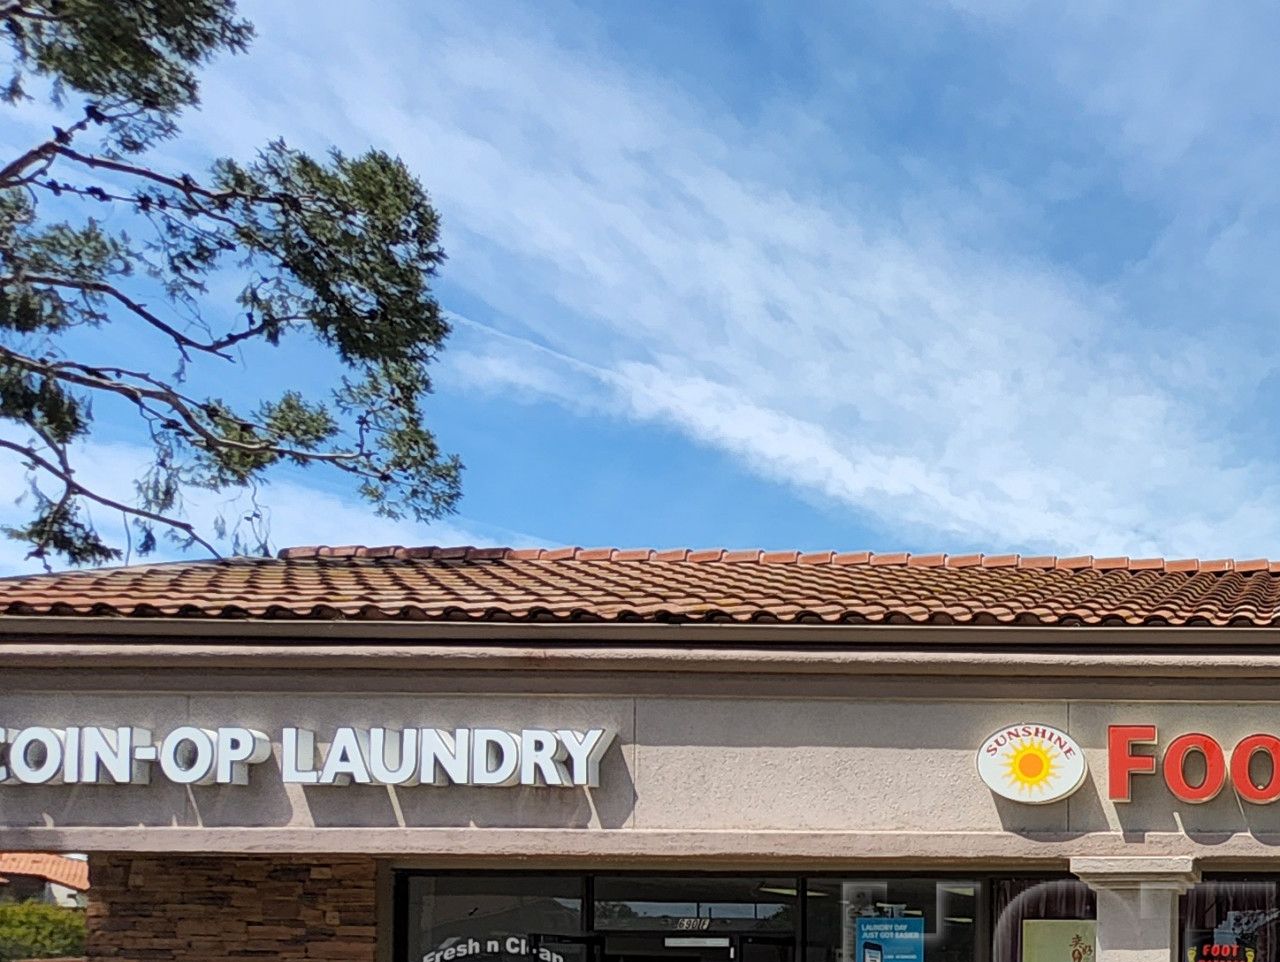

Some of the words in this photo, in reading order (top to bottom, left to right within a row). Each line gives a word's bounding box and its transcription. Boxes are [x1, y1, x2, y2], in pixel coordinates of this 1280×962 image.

[985, 726, 1076, 760] SUNSHINE
[282, 727, 607, 786] LAUNDRY
[486, 940, 499, 953] n
[1203, 944, 1239, 957] FOOT
